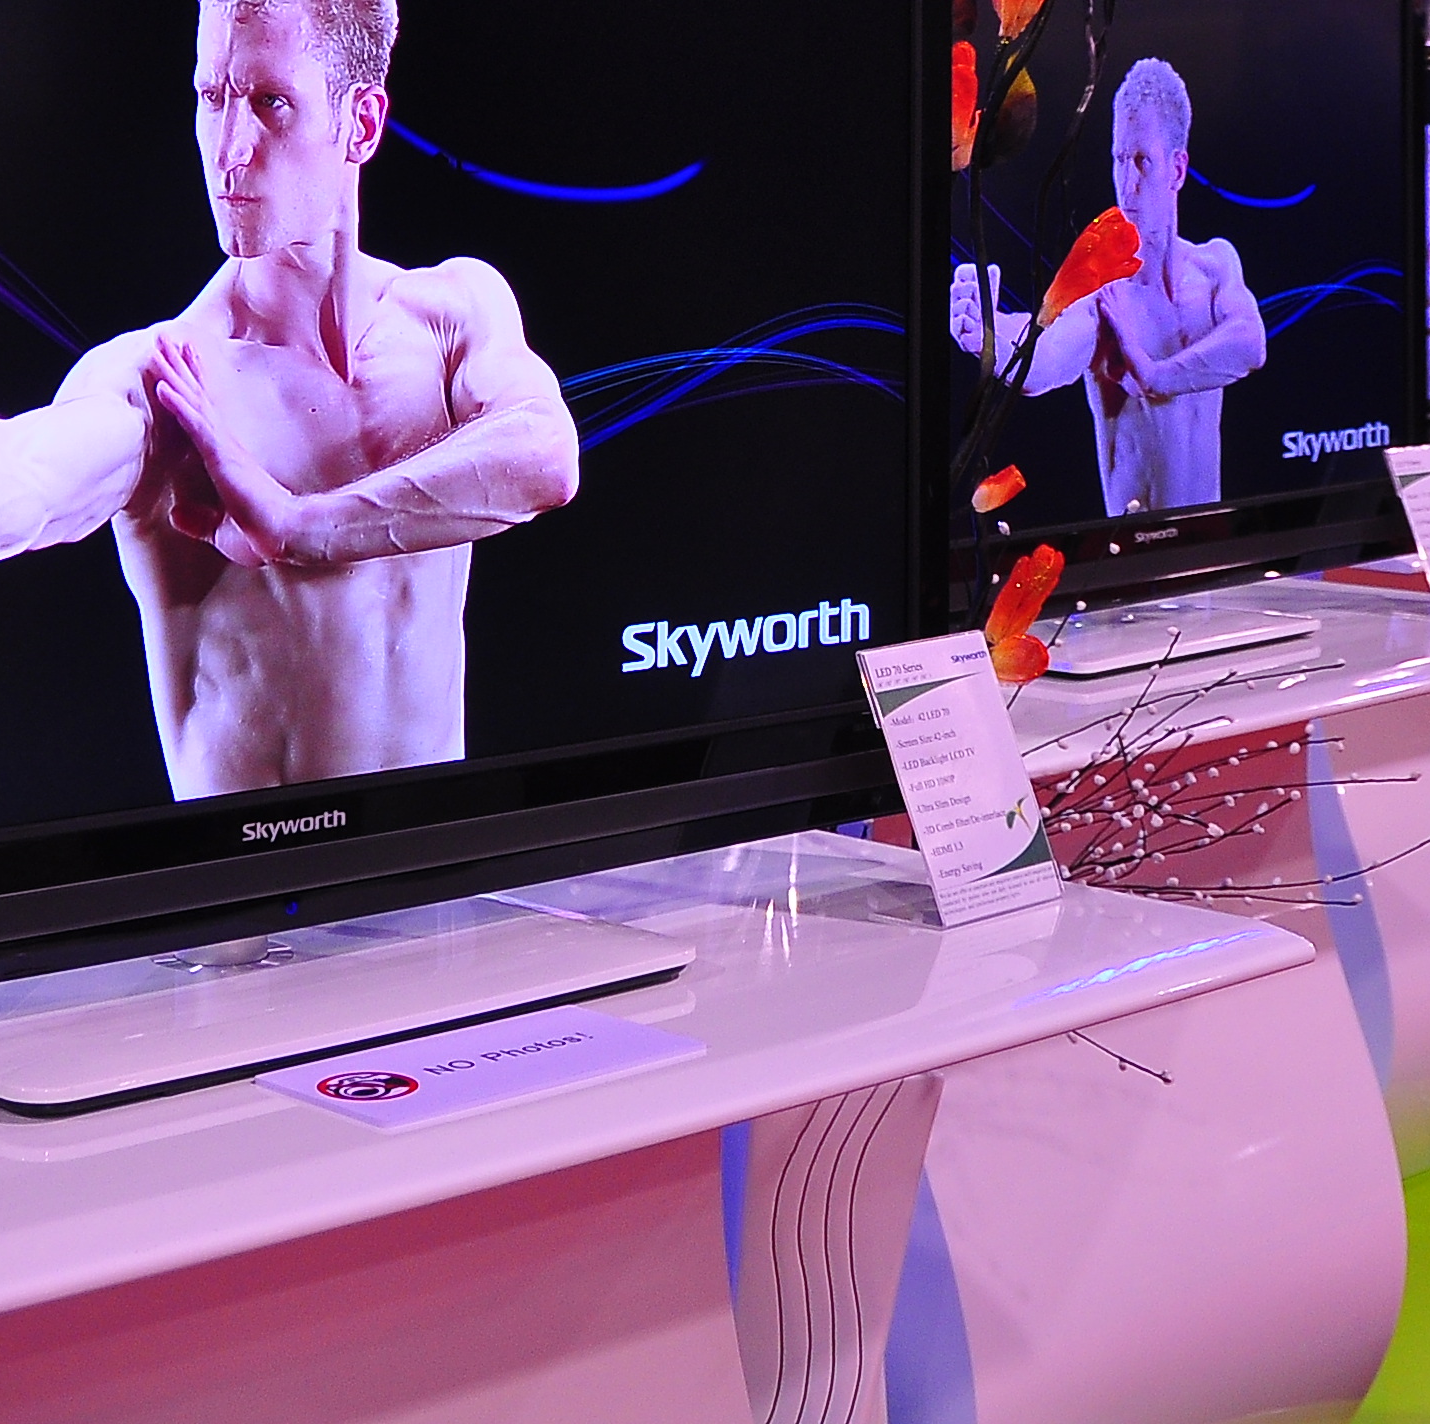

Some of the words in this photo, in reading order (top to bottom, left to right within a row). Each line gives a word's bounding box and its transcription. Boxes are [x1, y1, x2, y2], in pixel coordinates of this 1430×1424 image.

[1282, 421, 1391, 463] Skyworth
[622, 598, 870, 677] Skyworth
[242, 809, 346, 843] Skyworth
[482, 1030, 595, 1065] Photos!
